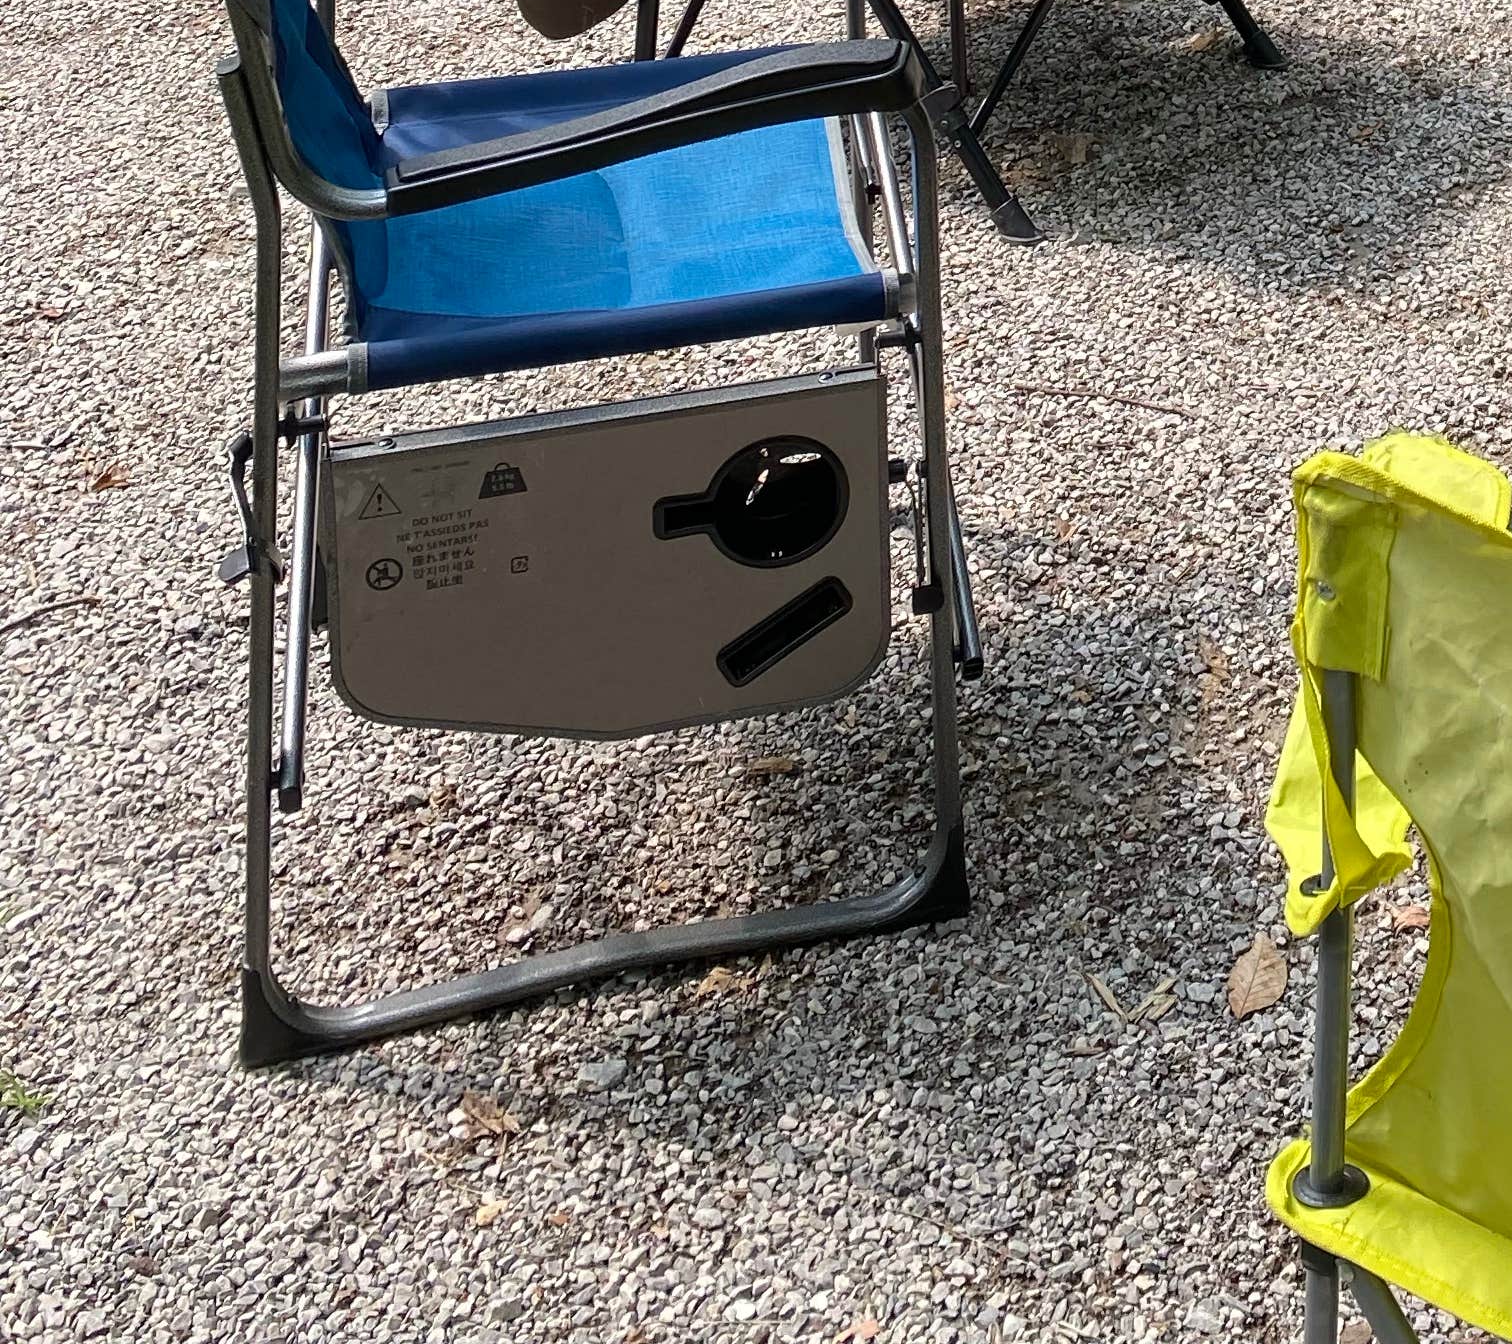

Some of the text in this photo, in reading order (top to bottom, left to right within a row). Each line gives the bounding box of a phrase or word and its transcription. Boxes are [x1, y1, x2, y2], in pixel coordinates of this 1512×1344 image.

[412, 508, 473, 527] DO NOT SIT
[406, 543, 423, 554] NO
